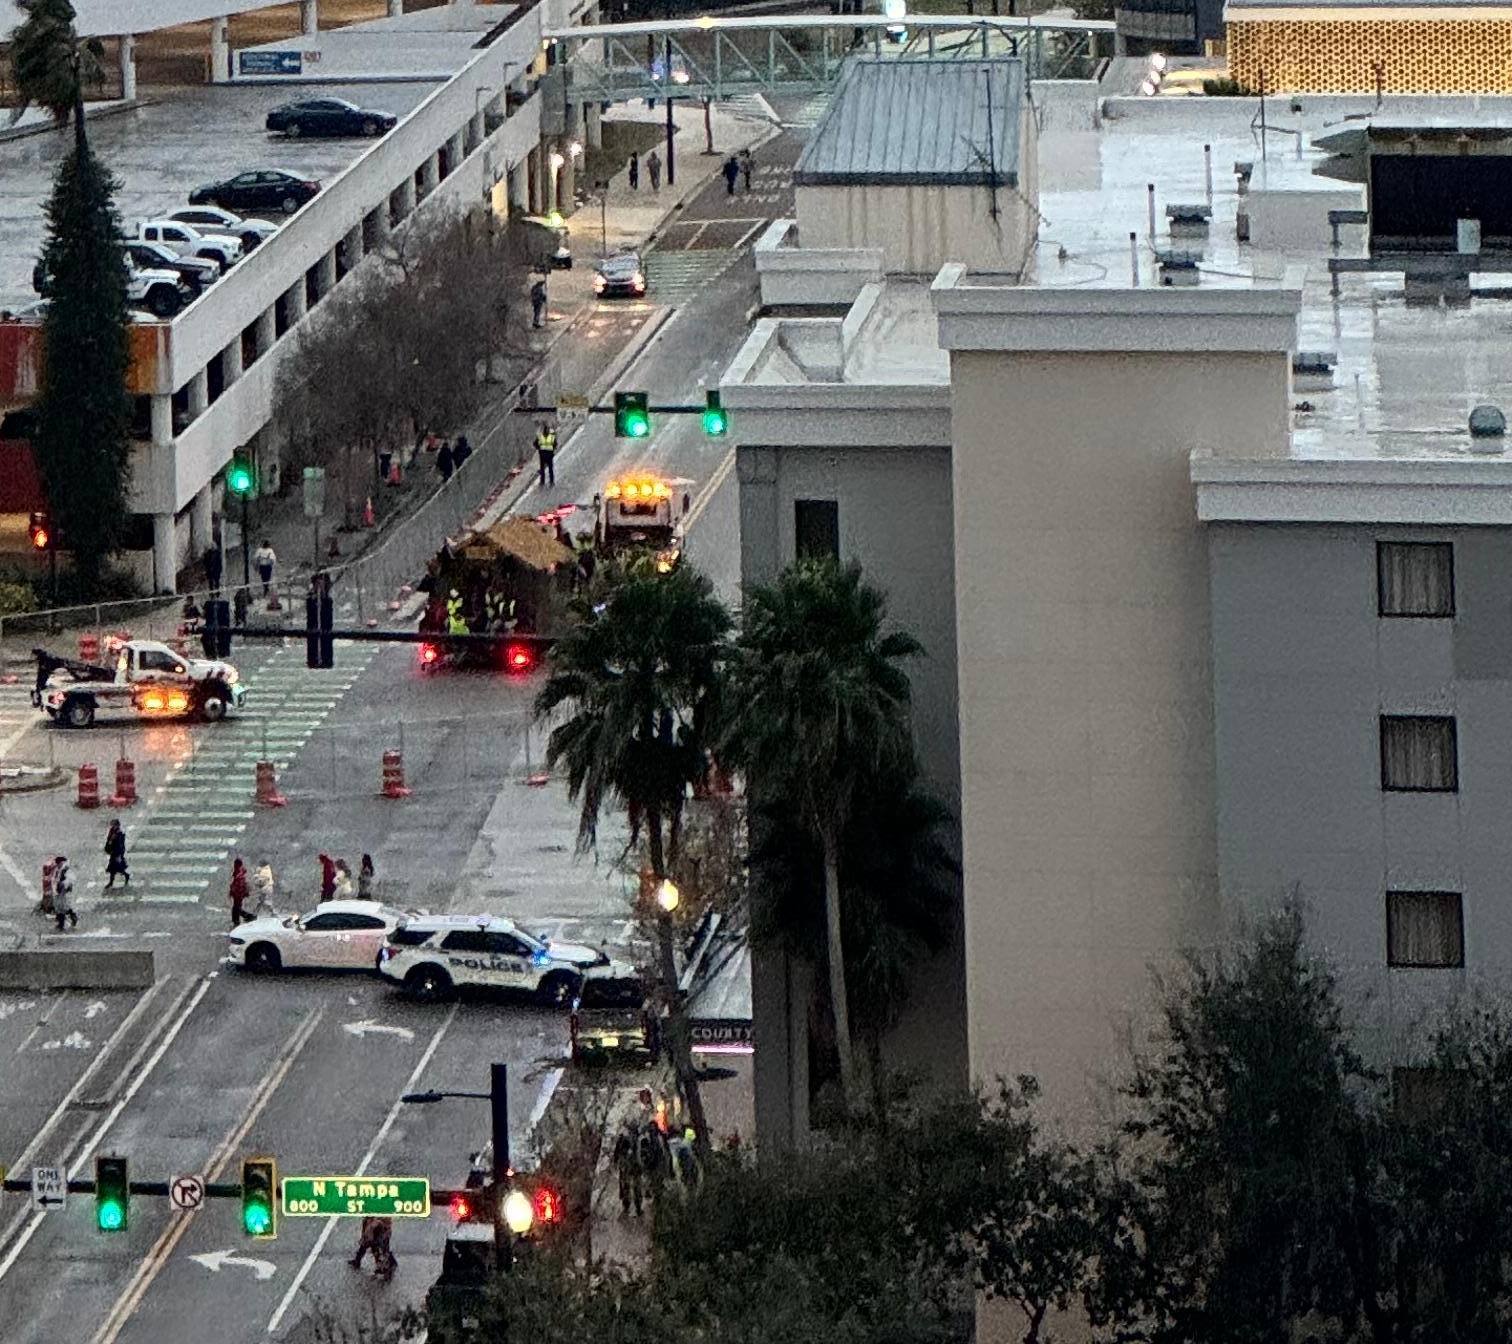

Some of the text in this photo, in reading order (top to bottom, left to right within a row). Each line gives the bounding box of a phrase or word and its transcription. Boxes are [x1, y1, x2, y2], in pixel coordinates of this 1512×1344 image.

[448, 957, 525, 973] POLICE
[37, 1181, 61, 1192] WAY
[313, 1181, 399, 1199] N Tampa
[289, 1200, 423, 1212] 800 ST 900
